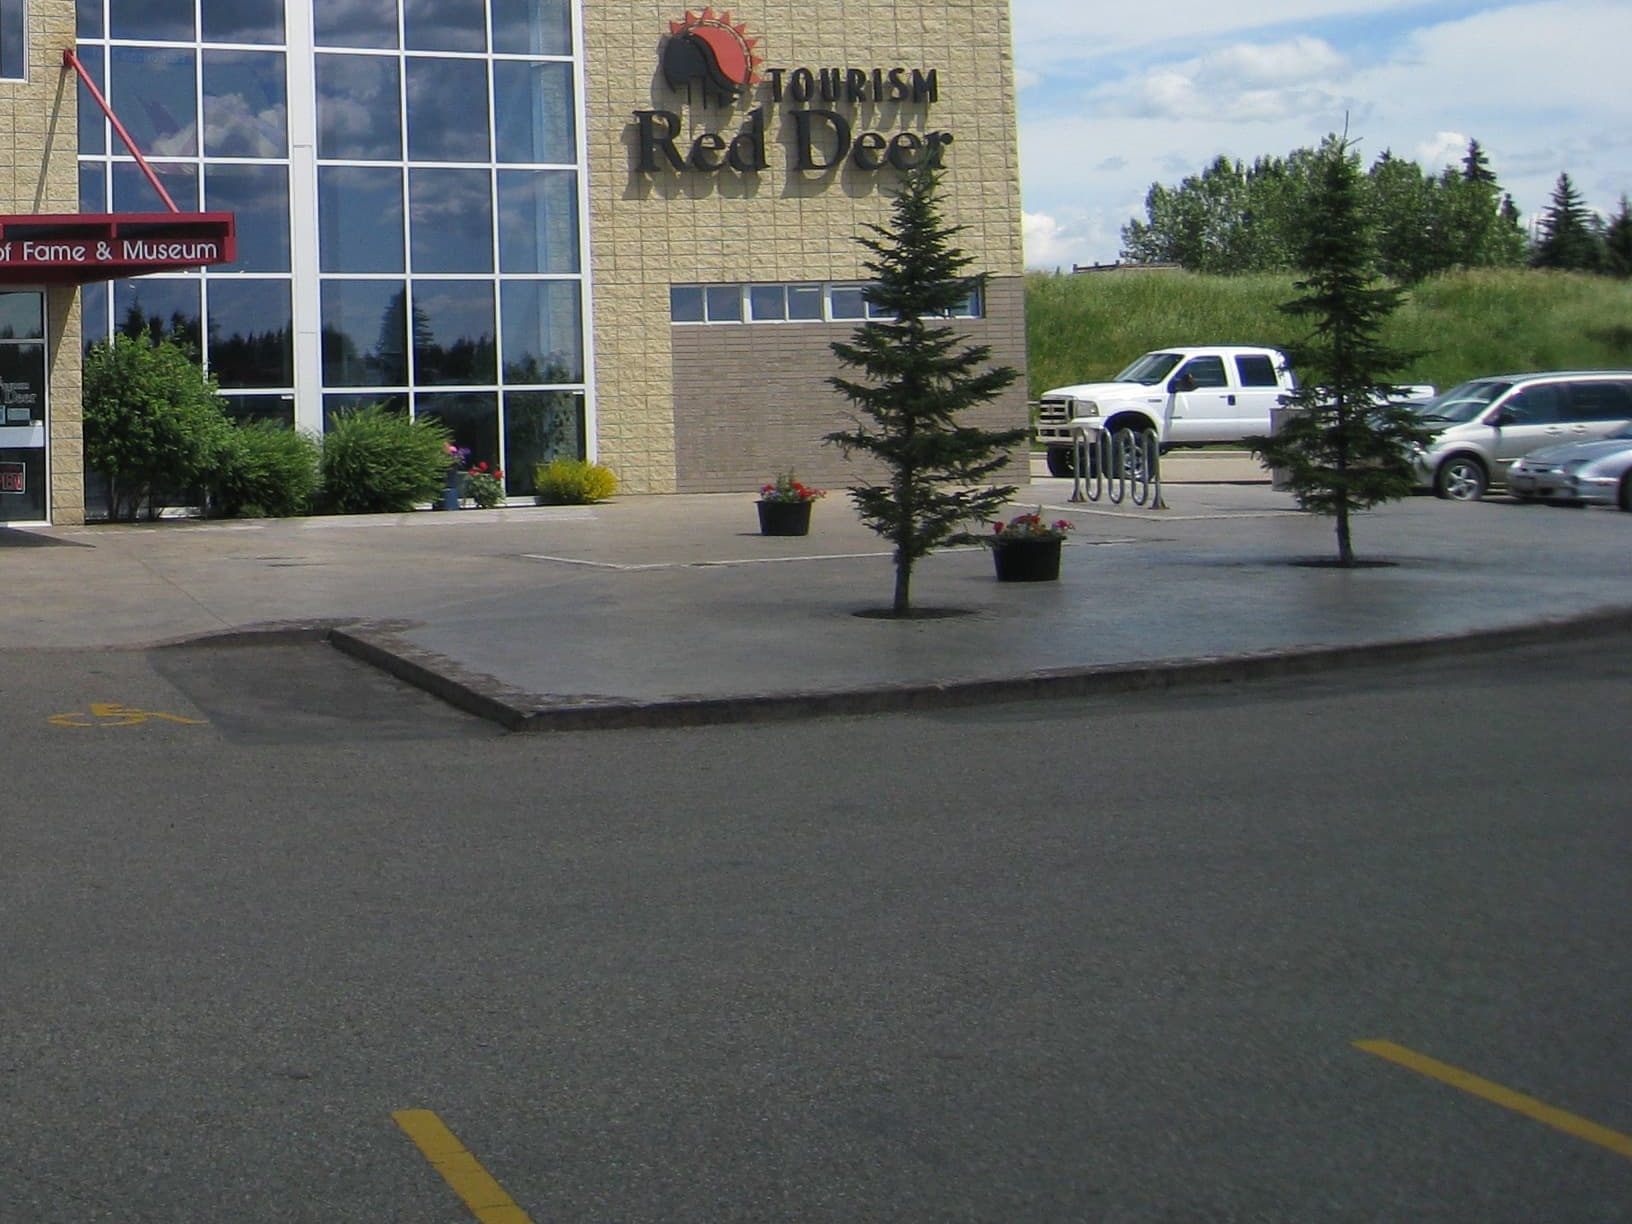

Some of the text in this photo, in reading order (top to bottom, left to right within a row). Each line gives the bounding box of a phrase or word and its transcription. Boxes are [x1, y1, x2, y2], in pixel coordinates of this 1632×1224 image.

[766, 67, 939, 104] TOURISM
[632, 106, 955, 173] Red Deer
[23, 241, 86, 262] Fame
[96, 240, 113, 261] &
[123, 240, 218, 260] Museum
